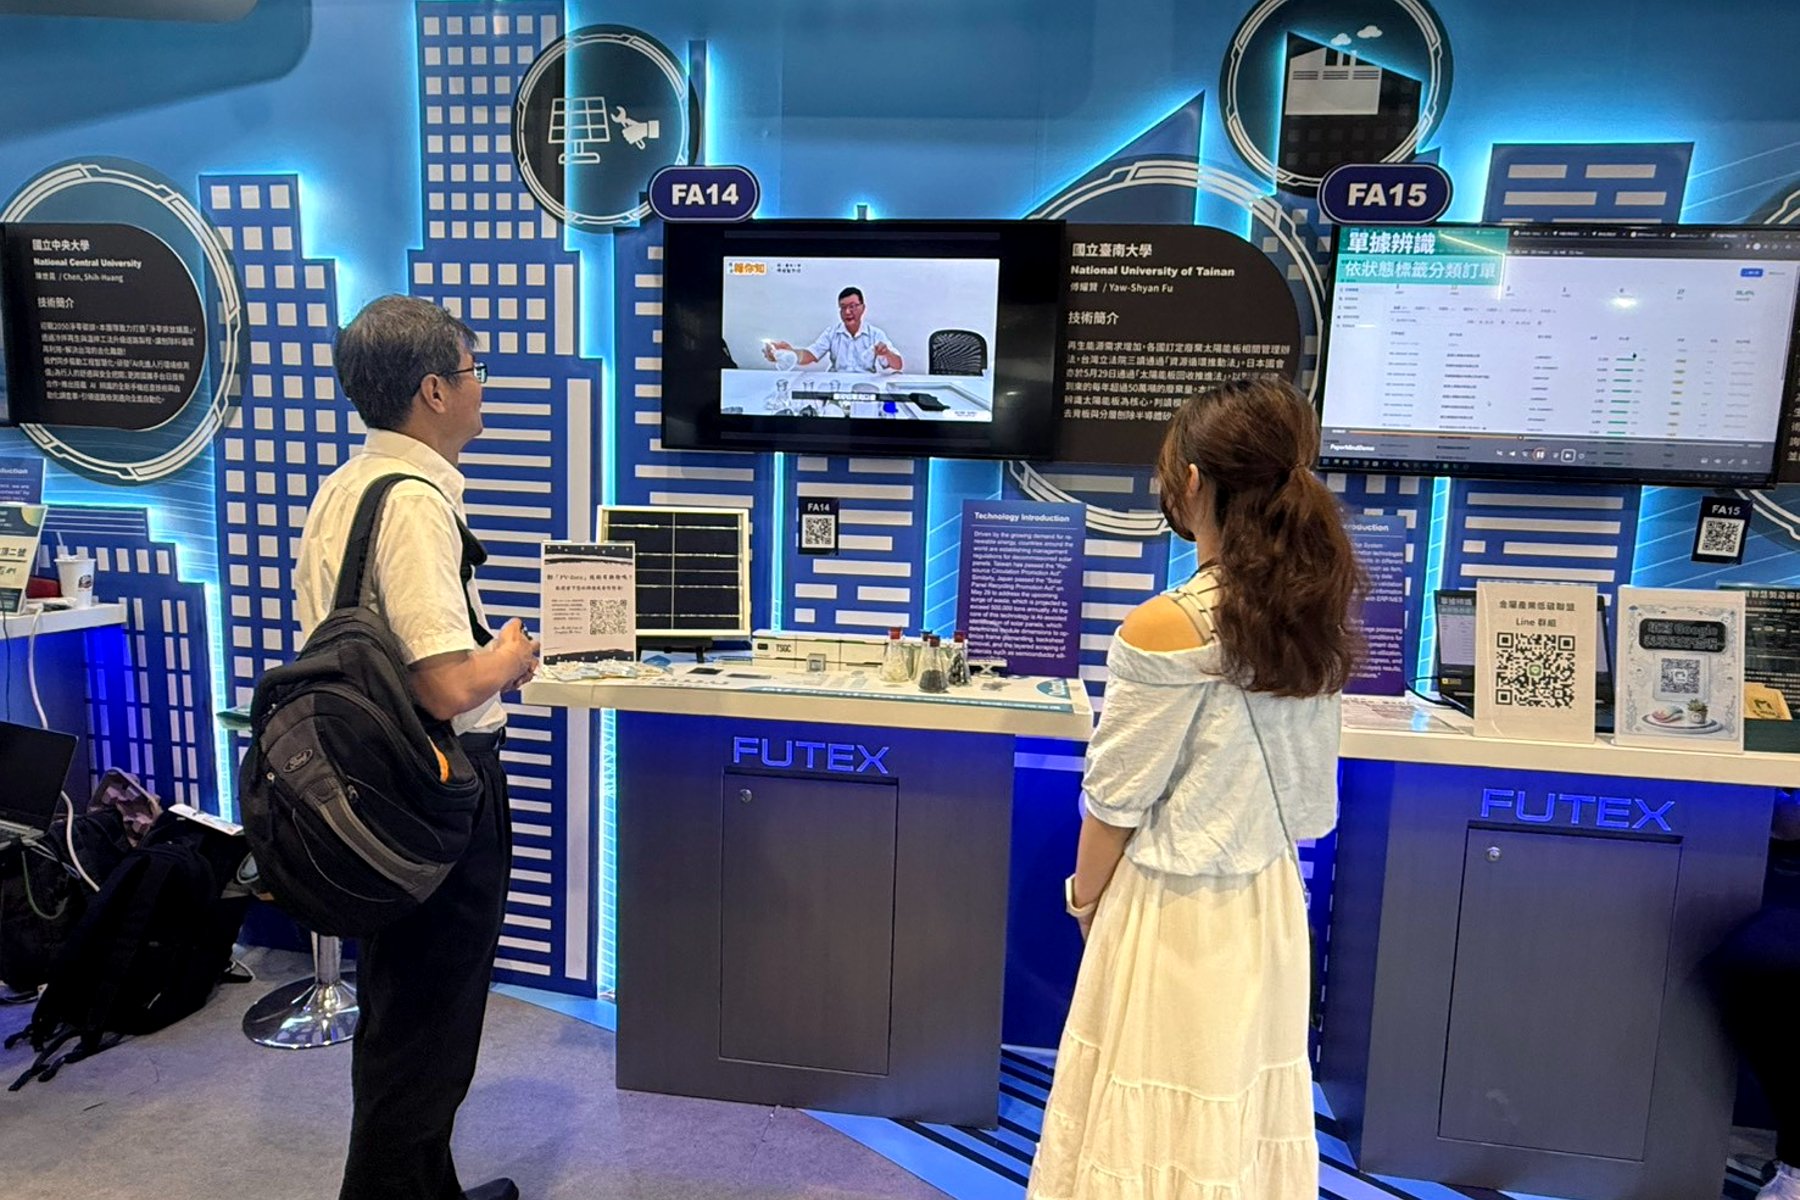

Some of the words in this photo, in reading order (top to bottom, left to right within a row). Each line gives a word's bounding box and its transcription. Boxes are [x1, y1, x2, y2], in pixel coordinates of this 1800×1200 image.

[672, 183, 739, 206] FA14
[1347, 183, 1428, 207] FA15
[32, 239, 90, 251] 國立中央大學
[1348, 231, 1436, 255] 單據辨識
[1072, 243, 1153, 258] 國立臺南大學
[33, 257, 69, 267] National
[69, 258, 99, 267] Central
[100, 259, 142, 269] University
[1070, 265, 1118, 276] National
[1120, 266, 1178, 278] University
[1180, 266, 1194, 276] of
[1196, 267, 1235, 277] Tainan
[1345, 260, 1497, 280] 依狀態標籤分類訂單
[1109, 283, 1160, 294] Yaw-Shyan
[1162, 284, 1174, 293] Fu
[37, 297, 75, 309] 技術簡介
[1068, 311, 1119, 325] 技術簡介
[807, 502, 830, 512] FA14
[1711, 504, 1741, 516] FA15
[974, 511, 1019, 522] Technology
[1021, 513, 1070, 522] Introduction
[1516, 617, 1536, 626] Line
[1538, 618, 1557, 628] 群組
[733, 736, 890, 774] FUTEX
[1480, 788, 1676, 832] FUTEX
